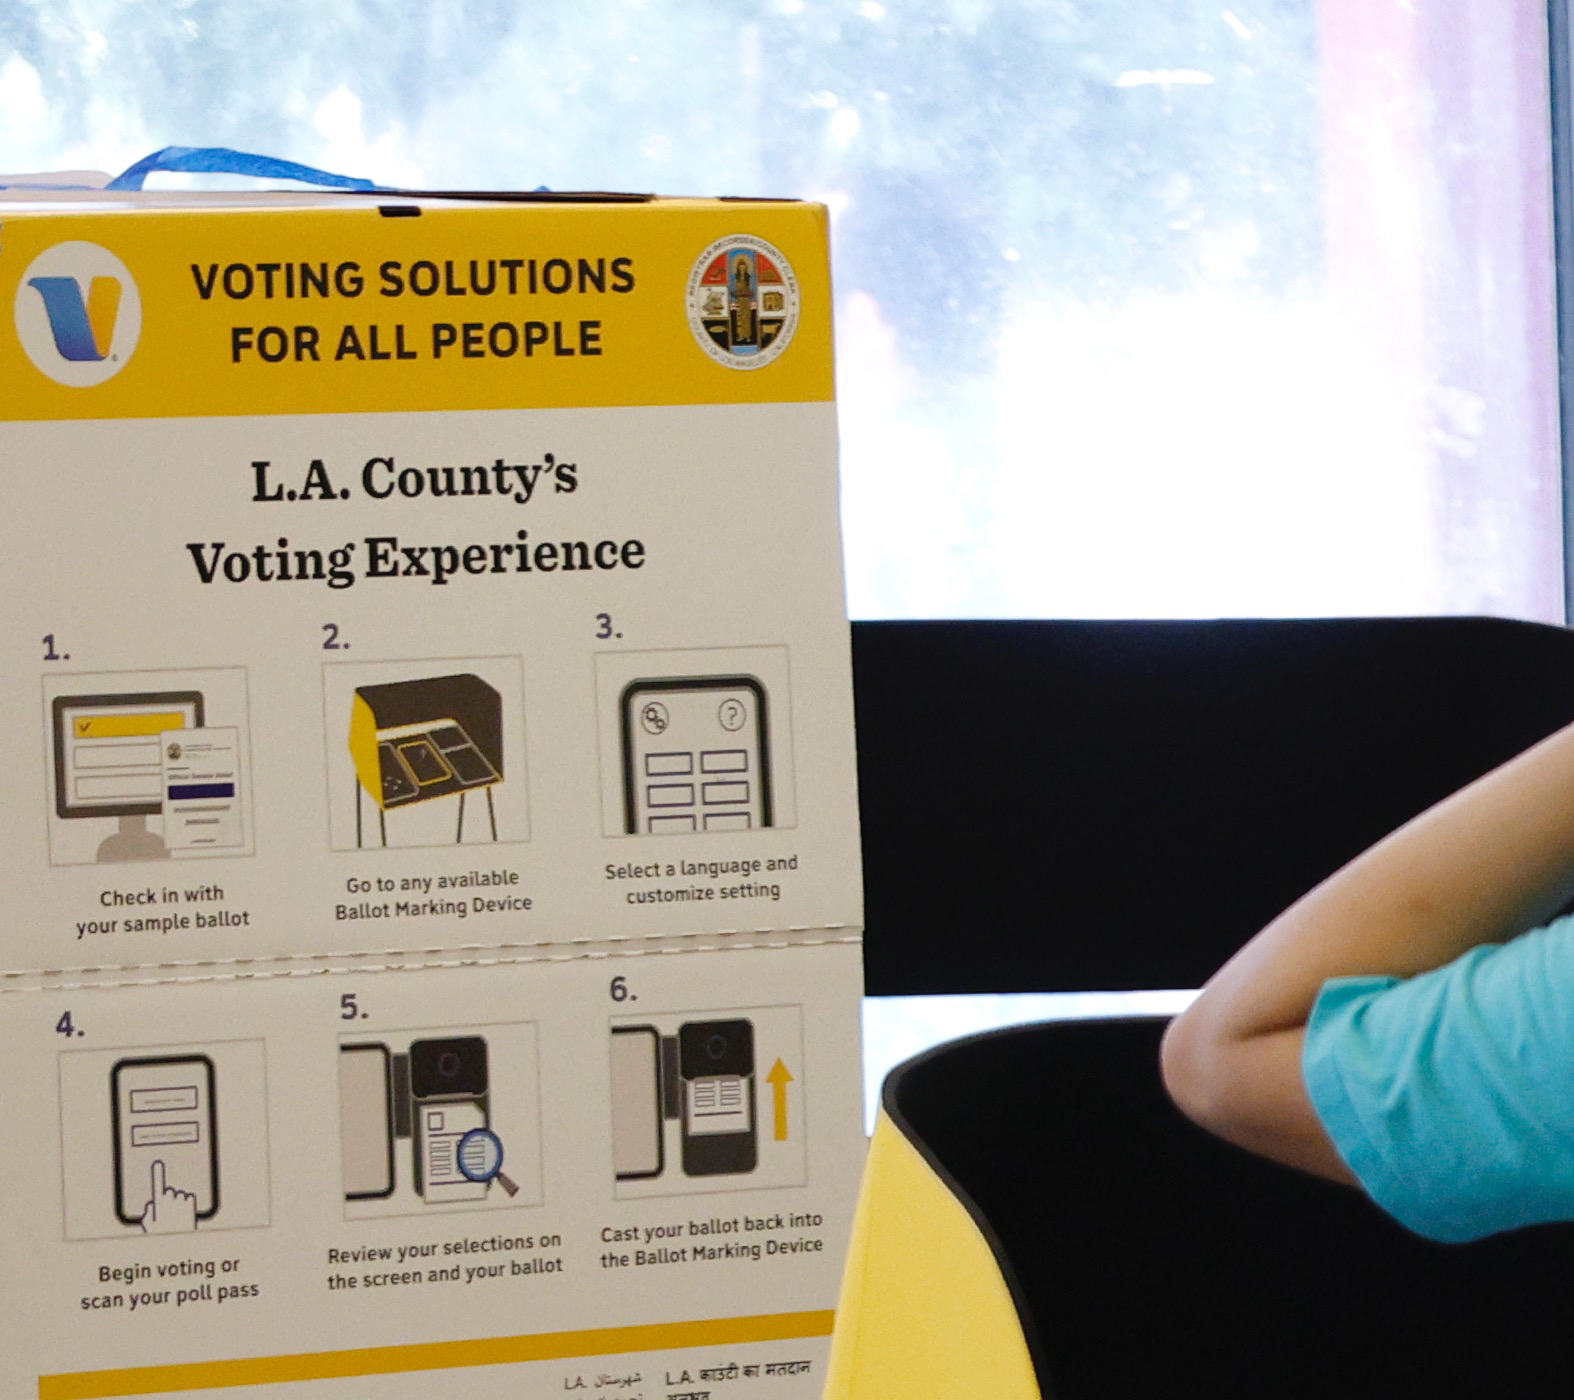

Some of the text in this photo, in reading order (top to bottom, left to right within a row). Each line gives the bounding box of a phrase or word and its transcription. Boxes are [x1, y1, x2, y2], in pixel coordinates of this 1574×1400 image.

[191, 258, 634, 299] VOTING SOLUTIONS
[232, 321, 602, 362] FOR ALL PEOPLE
[252, 460, 350, 501] L.A.
[186, 530, 644, 589] Voting Experience
[322, 623, 349, 649] 2.
[596, 613, 622, 639] 3.
[43, 634, 70, 660] 1.
[606, 855, 797, 879] Select a language and
[347, 870, 519, 894] Go to any available
[627, 884, 780, 904] customize setting
[101, 885, 223, 906] Check in with
[336, 896, 532, 920] Ballot Marking Device
[77, 911, 249, 940] your sample ballot
[610, 976, 637, 1002] 6.
[341, 994, 368, 1019] 5.
[56, 1011, 84, 1037] 4.
[601, 1213, 822, 1244] Cast your ballot back into
[329, 1235, 561, 1264] Review your selections on
[600, 1238, 823, 1268] the Ballot Marking Device
[99, 1259, 239, 1285] Begin voting or
[328, 1258, 563, 1290] the screen and your ballot
[81, 1284, 259, 1311] scan your poll pass
[666, 1370, 694, 1386] L.A.
